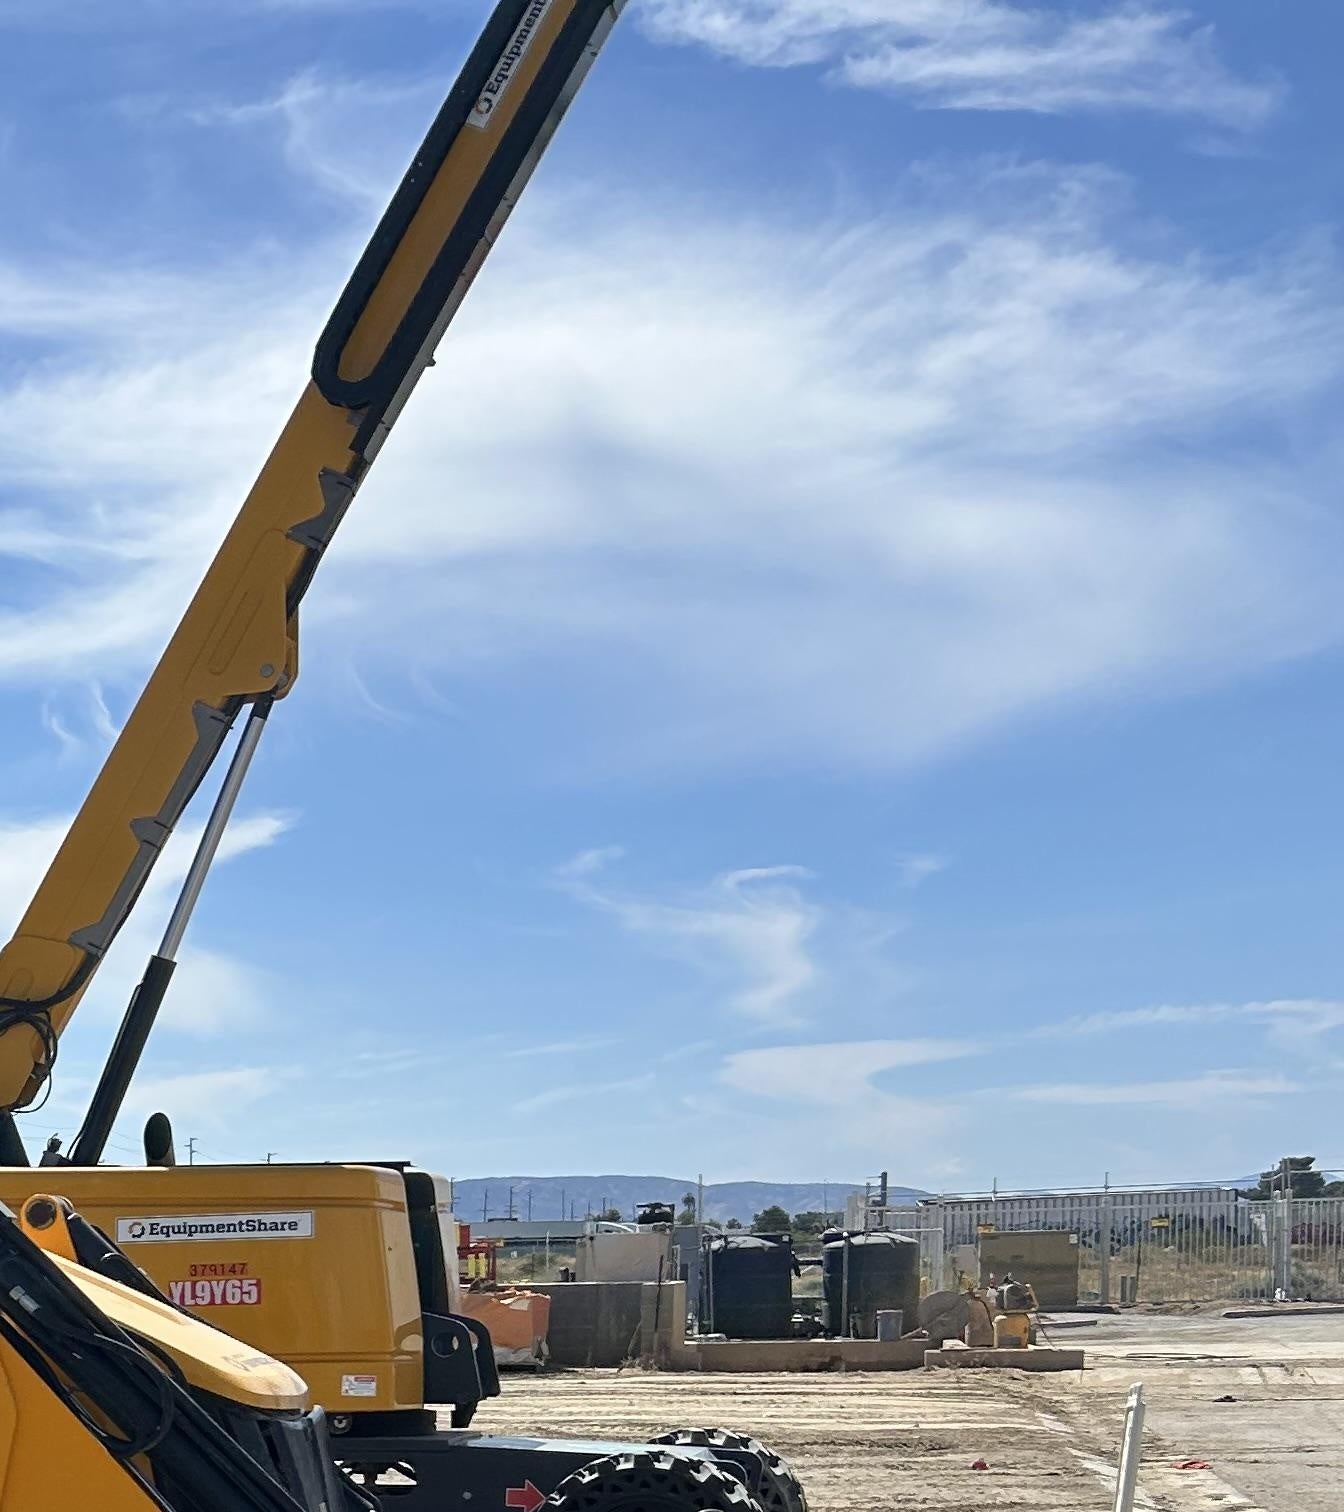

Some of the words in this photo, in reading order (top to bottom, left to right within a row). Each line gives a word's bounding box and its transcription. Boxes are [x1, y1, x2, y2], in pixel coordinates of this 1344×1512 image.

[148, 1219, 298, 1238] EquipmentShare
[189, 1263, 248, 1277] 379147
[169, 1279, 258, 1305] YL9Y65
